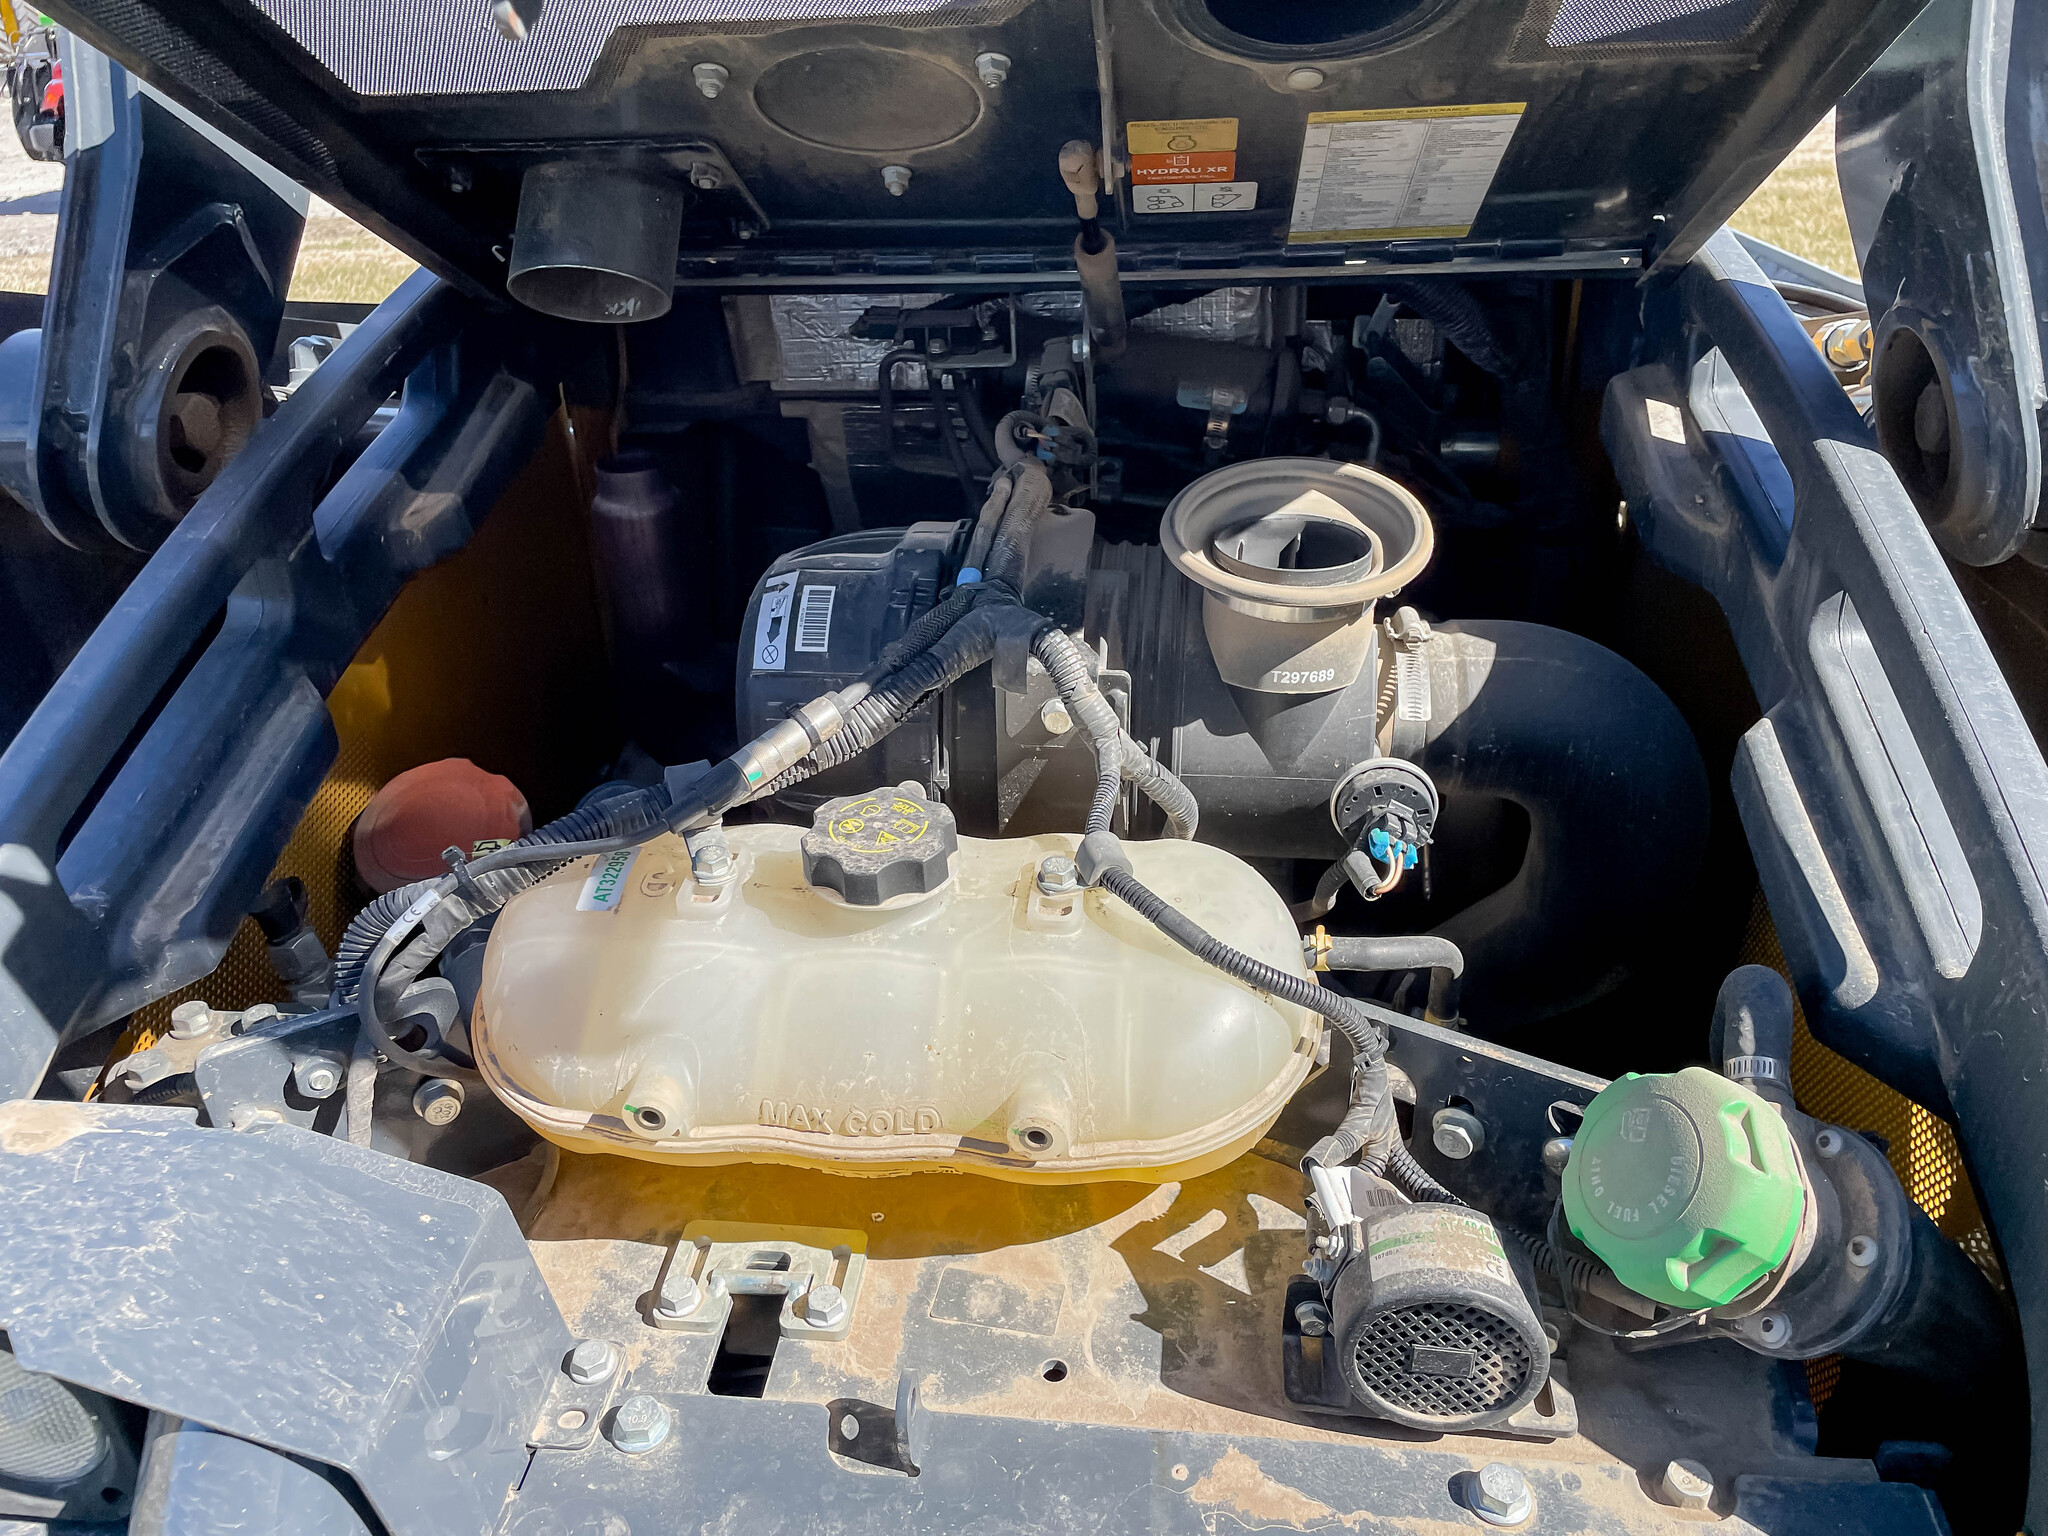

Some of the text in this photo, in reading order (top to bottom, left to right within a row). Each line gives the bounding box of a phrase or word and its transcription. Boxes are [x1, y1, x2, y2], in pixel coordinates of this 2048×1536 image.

[1136, 167, 1202, 176] HYDRAU
[1270, 668, 1335, 684] T297689
[593, 849, 632, 903] AT322958
[757, 1098, 944, 1138] MAX COLD
[1647, 1155, 1685, 1215] DIESEL
[1607, 1200, 1640, 1222] FUEL
